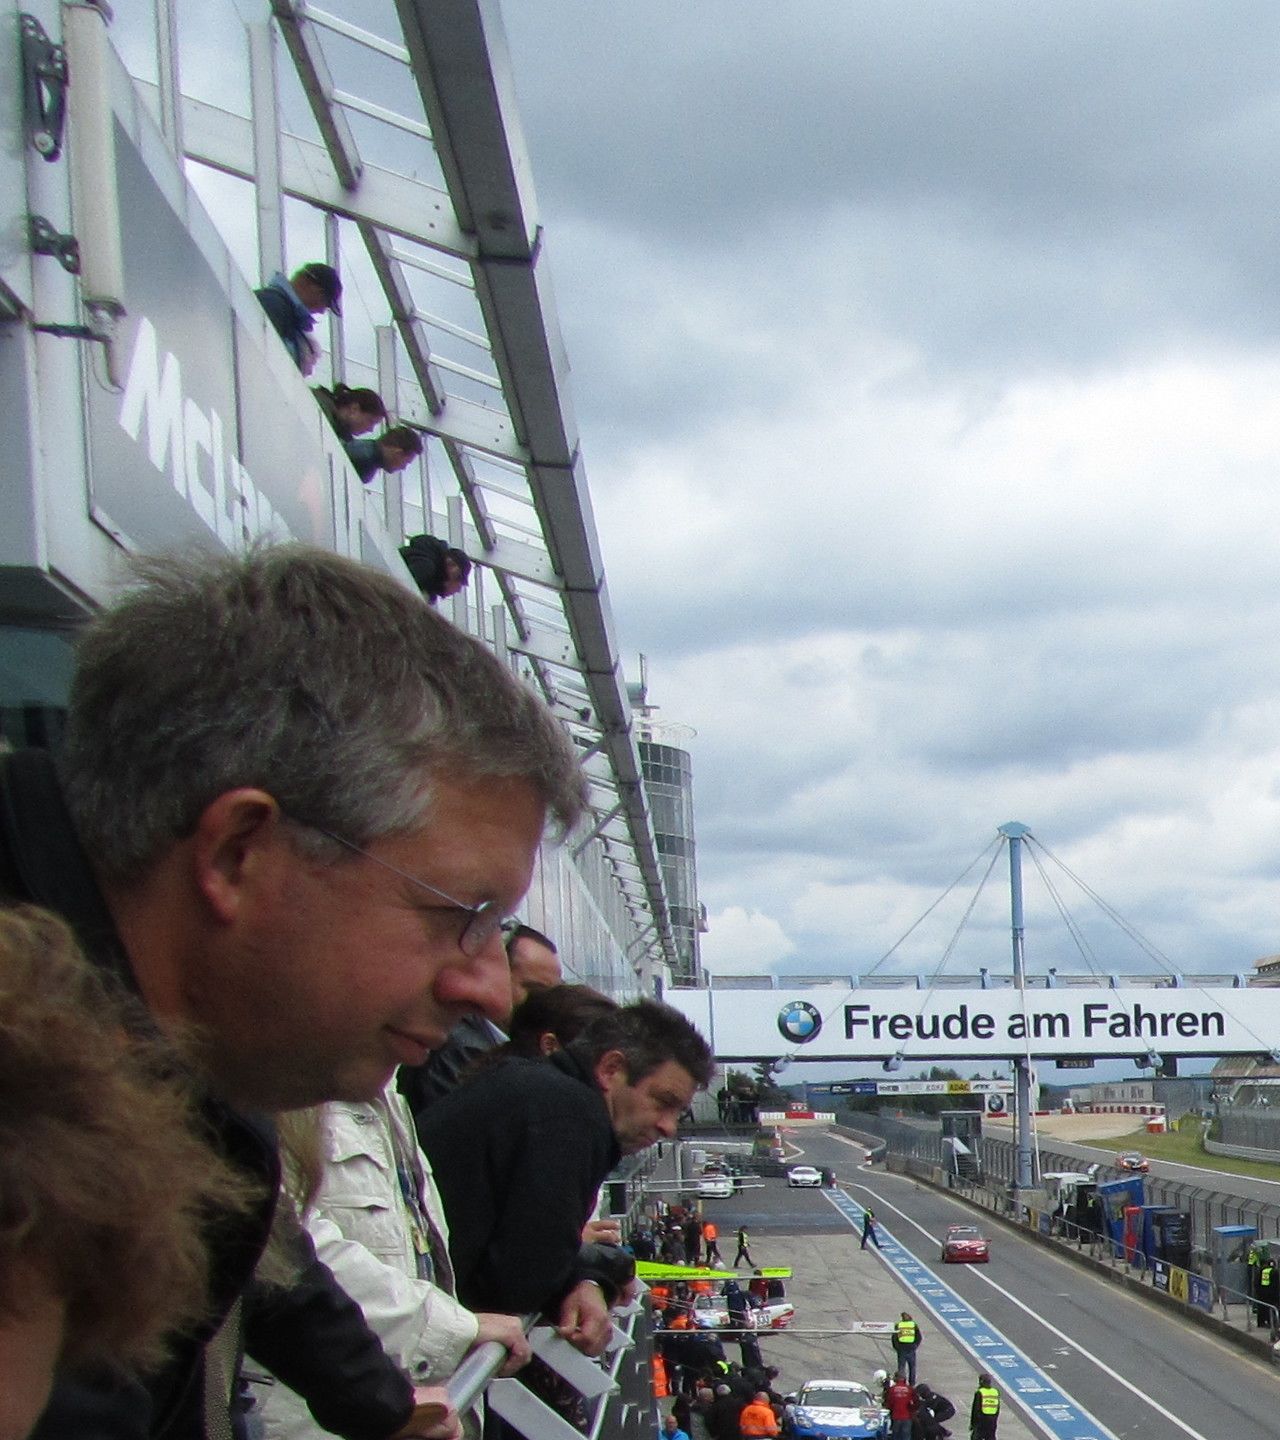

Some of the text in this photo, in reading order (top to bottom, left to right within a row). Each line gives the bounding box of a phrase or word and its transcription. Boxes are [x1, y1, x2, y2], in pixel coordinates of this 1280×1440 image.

[844, 1002, 1226, 1040] Freude am Fahren
